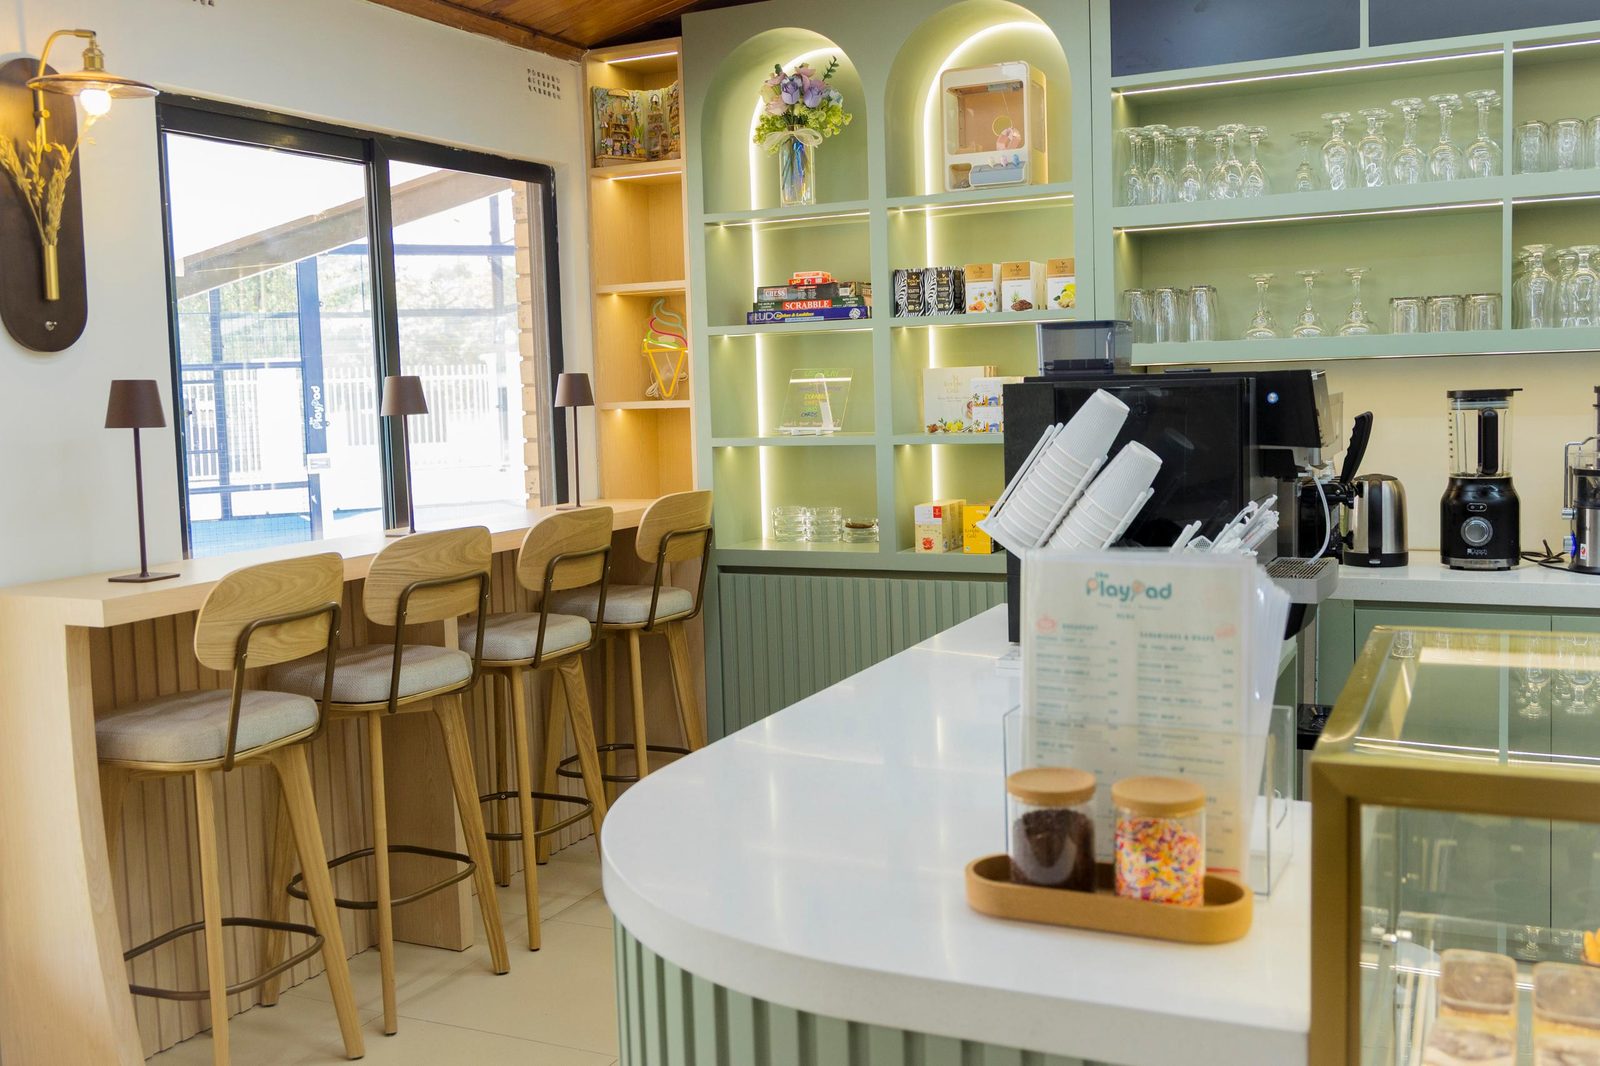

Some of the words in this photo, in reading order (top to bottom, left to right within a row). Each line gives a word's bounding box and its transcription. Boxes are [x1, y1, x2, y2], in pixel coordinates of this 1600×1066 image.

[765, 289, 786, 297] CHESS
[785, 300, 829, 310] SCRABBLE
[754, 312, 782, 321] LUDO
[1086, 577, 1172, 602] PlayPad
